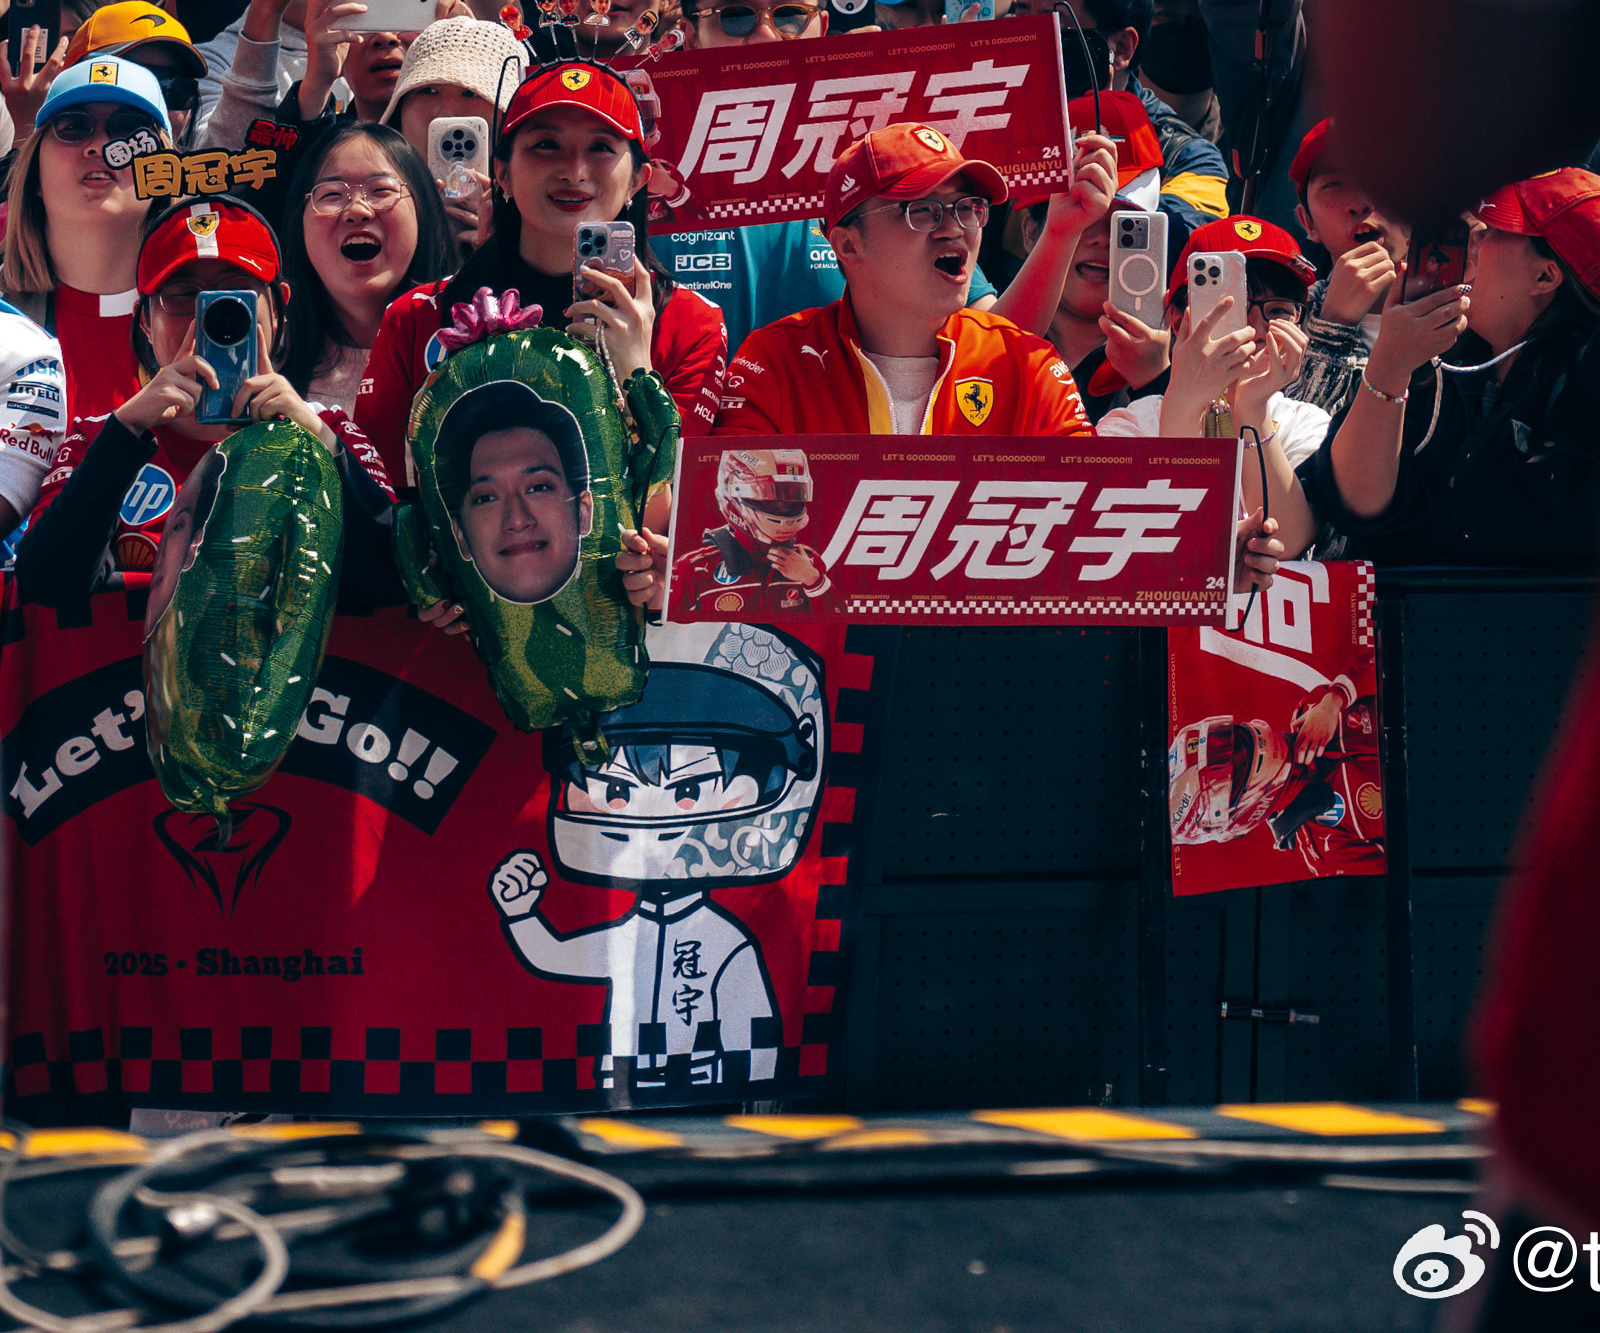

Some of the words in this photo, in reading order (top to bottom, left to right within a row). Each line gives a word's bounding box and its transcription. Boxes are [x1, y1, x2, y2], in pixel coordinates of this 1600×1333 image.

[970, 37, 990, 48] LET'S
[888, 46, 908, 55] LET'S
[806, 53, 826, 63] LET'S
[721, 63, 741, 72] LET'S
[677, 59, 1030, 185] 周冠宇
[1042, 145, 1060, 159] 24
[134, 148, 277, 198] 周冠宇
[996, 160, 1062, 174] OUGUANYU
[671, 231, 735, 244] cognizant
[810, 250, 836, 261] ara
[677, 256, 730, 269] JCB
[674, 280, 732, 290] entinelOne
[0, 429, 31, 452] Red
[30, 440, 53, 463] Bull
[973, 454, 994, 462] LET'S
[1061, 456, 1082, 464] LET'S
[1149, 457, 1169, 465] LET'S
[821, 479, 1208, 581] 周冠宇
[1206, 576, 1225, 589] 24
[1136, 591, 1225, 602] ZHOUGUANYU
[10, 690, 144, 819] Let'
[298, 687, 458, 800] Go!!
[104, 952, 168, 977] 2025
[196, 948, 364, 982] Shanghai
[673, 939, 707, 1026] 冠宇
